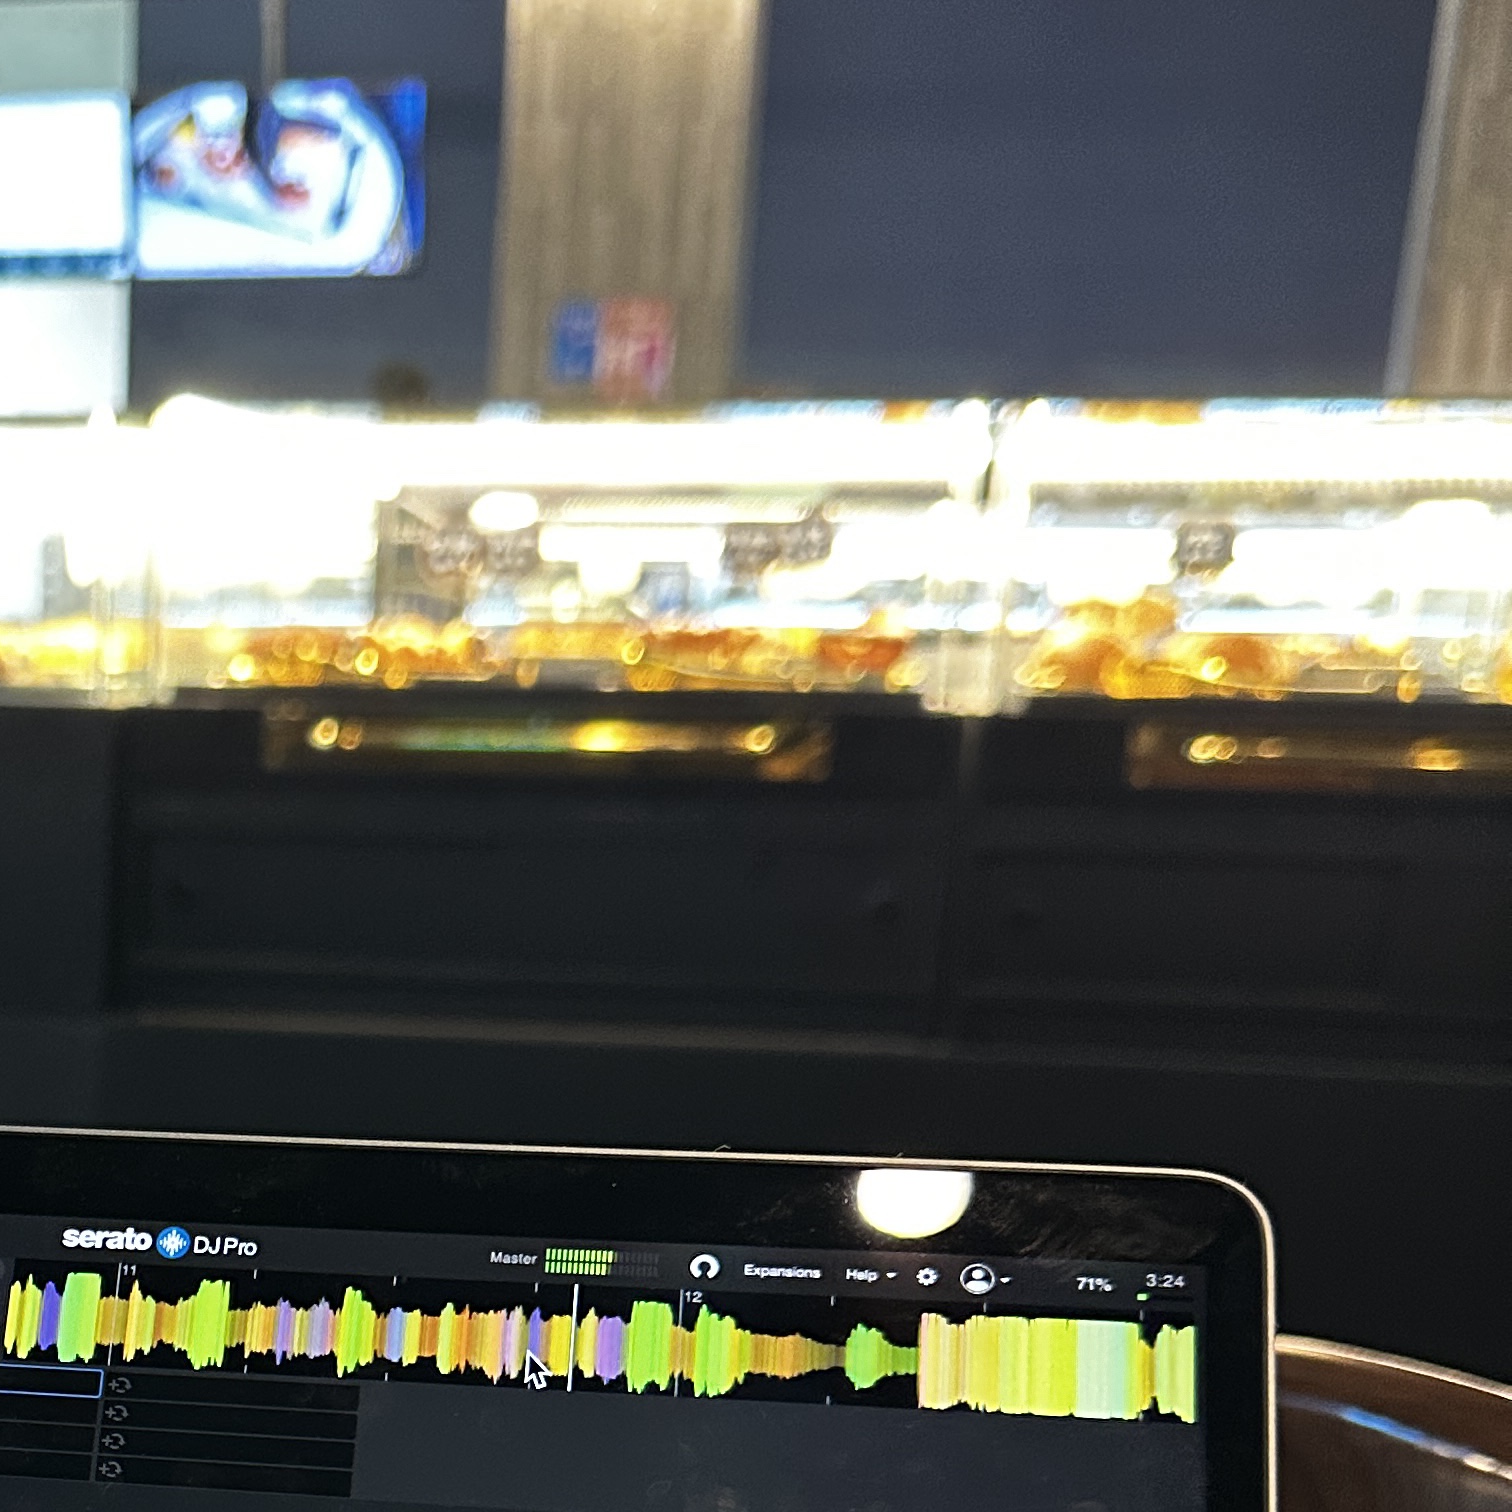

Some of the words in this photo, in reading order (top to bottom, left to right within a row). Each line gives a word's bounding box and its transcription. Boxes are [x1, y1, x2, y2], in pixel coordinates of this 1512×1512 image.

[61, 1227, 153, 1251] serato
[193, 1235, 221, 1255] DJ
[223, 1237, 257, 1256] Pro
[491, 1252, 537, 1264] Master
[123, 1265, 136, 1275] 11
[744, 1264, 821, 1278] Expansions
[846, 1269, 878, 1283] Help
[1077, 1277, 1112, 1291] 71%
[1147, 1274, 1184, 1287] 3:24
[686, 1291, 702, 1303] 12
